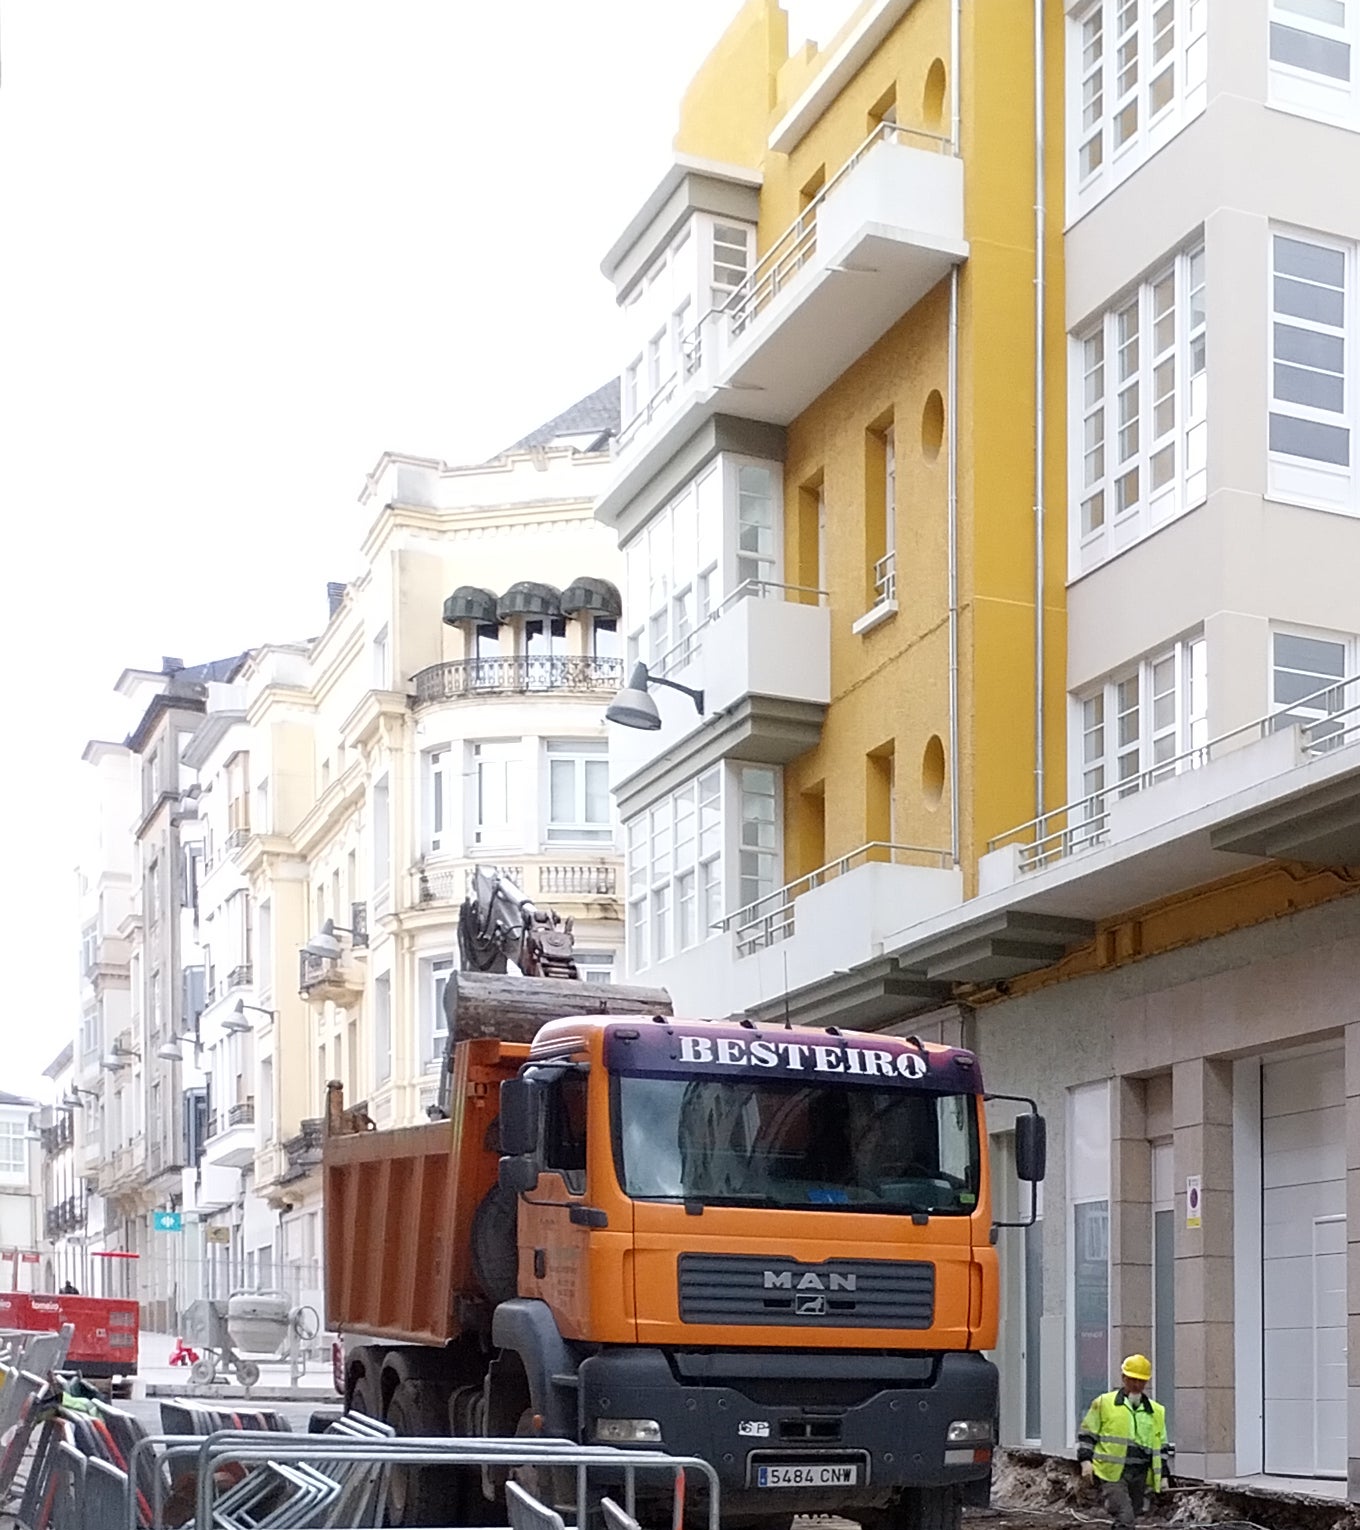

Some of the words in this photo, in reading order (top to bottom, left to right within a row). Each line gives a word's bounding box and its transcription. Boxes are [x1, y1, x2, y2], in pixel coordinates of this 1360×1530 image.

[678, 1035, 928, 1080] BESTEIRO
[763, 1271, 857, 1291] MAN
[771, 1469, 814, 1484] 5484
[820, 1468, 851, 1483] CNW
